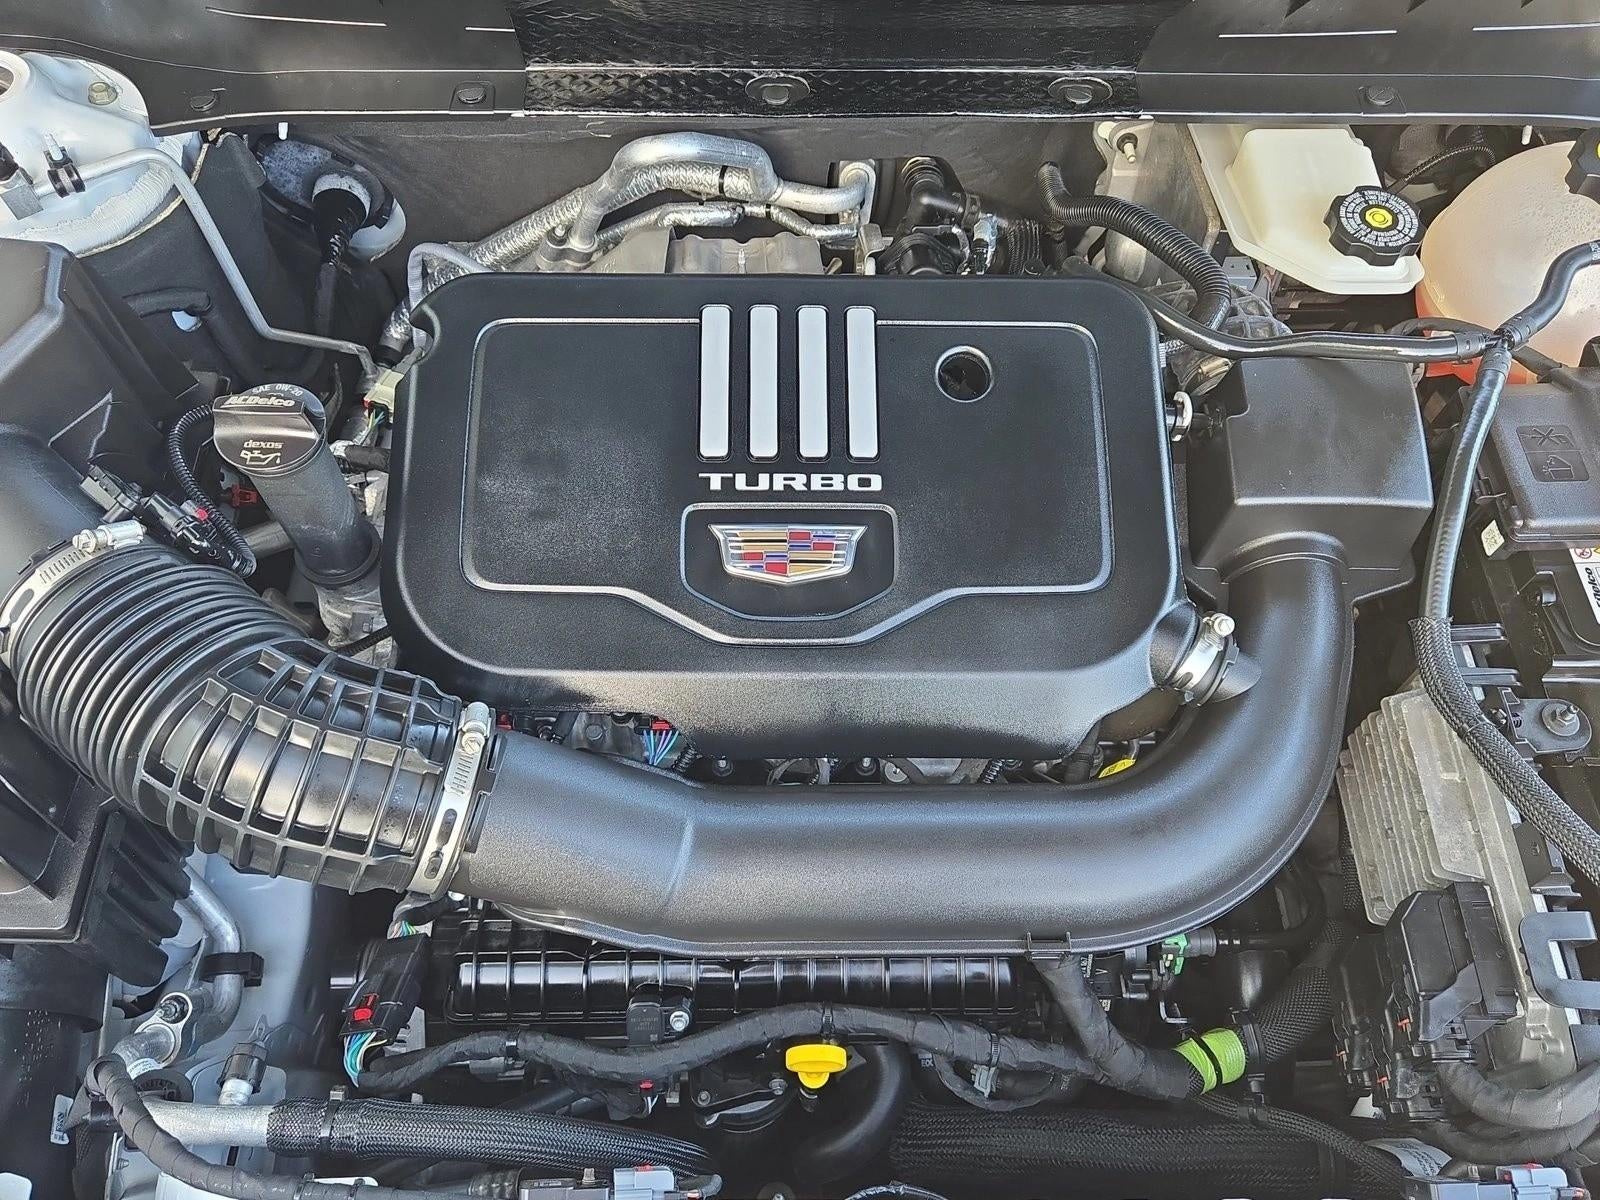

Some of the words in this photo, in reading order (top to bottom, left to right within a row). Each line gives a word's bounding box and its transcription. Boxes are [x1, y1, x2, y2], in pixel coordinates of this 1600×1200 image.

[251, 385, 271, 394] SAE
[223, 396, 296, 407] ACDelco
[243, 440, 284, 449] dexos
[698, 473, 883, 492] TURBO
